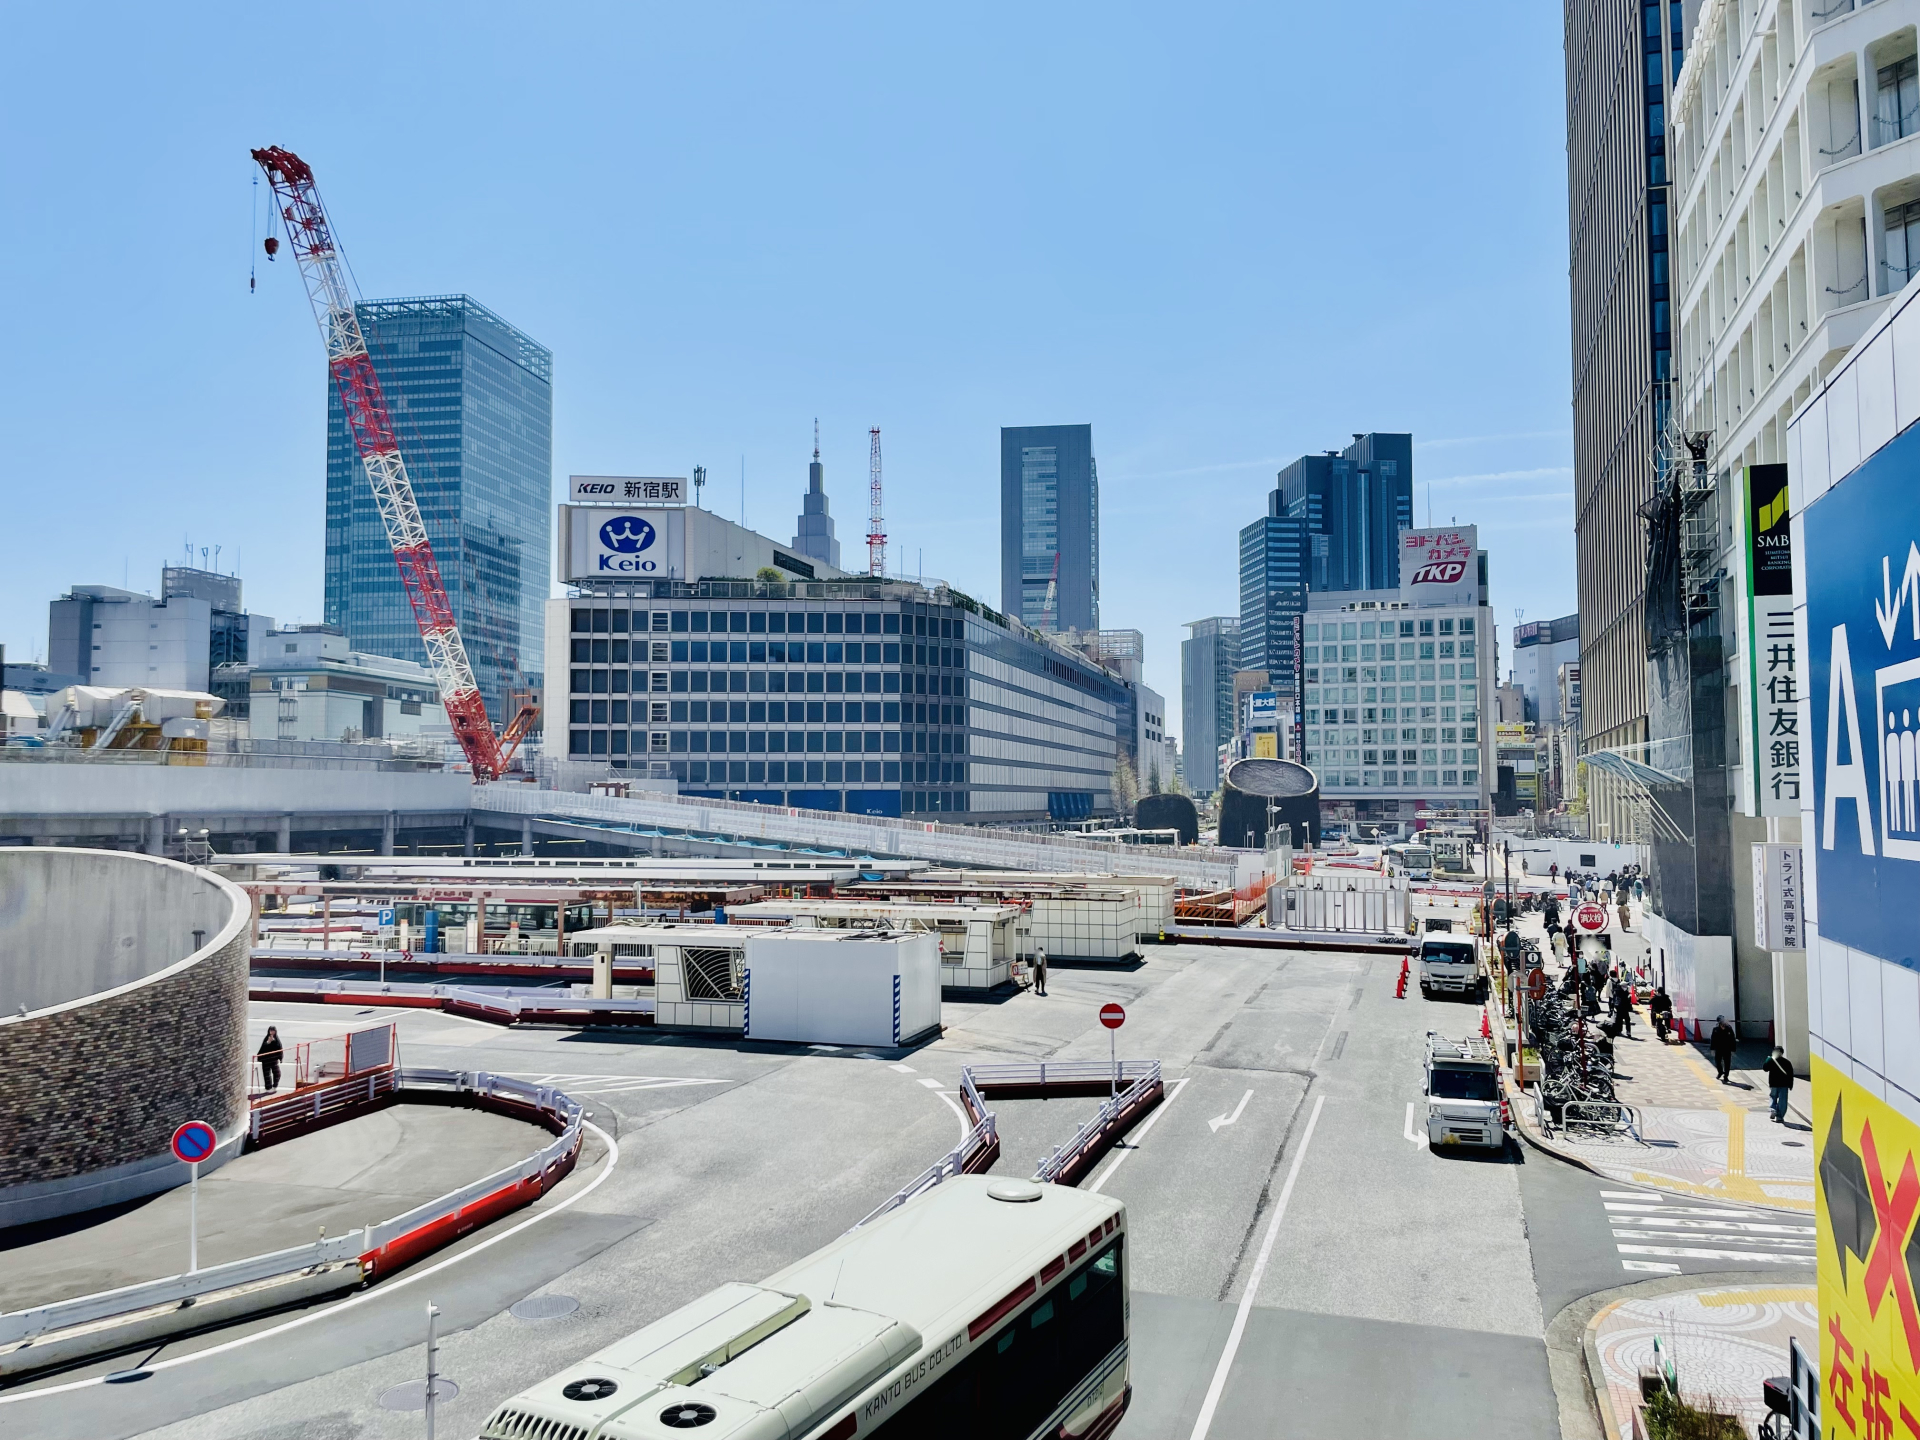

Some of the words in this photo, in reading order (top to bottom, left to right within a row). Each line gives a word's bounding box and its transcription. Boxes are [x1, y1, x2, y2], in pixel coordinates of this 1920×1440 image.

[577, 483, 615, 494] KEIO
[624, 481, 679, 499] 新宿駅
[1406, 533, 1465, 548] ヨドバシ
[1757, 535, 1790, 547] SMB
[1428, 546, 1472, 560] カメラ
[599, 554, 657, 571] Keio
[1416, 563, 1462, 581] TKP
[1767, 612, 1800, 800] 三井住友銀行
[1823, 623, 1876, 857] A
[1783, 851, 1796, 947] トライ式高等学院
[382, 910, 392, 924] P
[1580, 913, 1602, 923] 消火栓
[865, 1381, 901, 1420] KANTO
[904, 1362, 926, 1390] BUS
